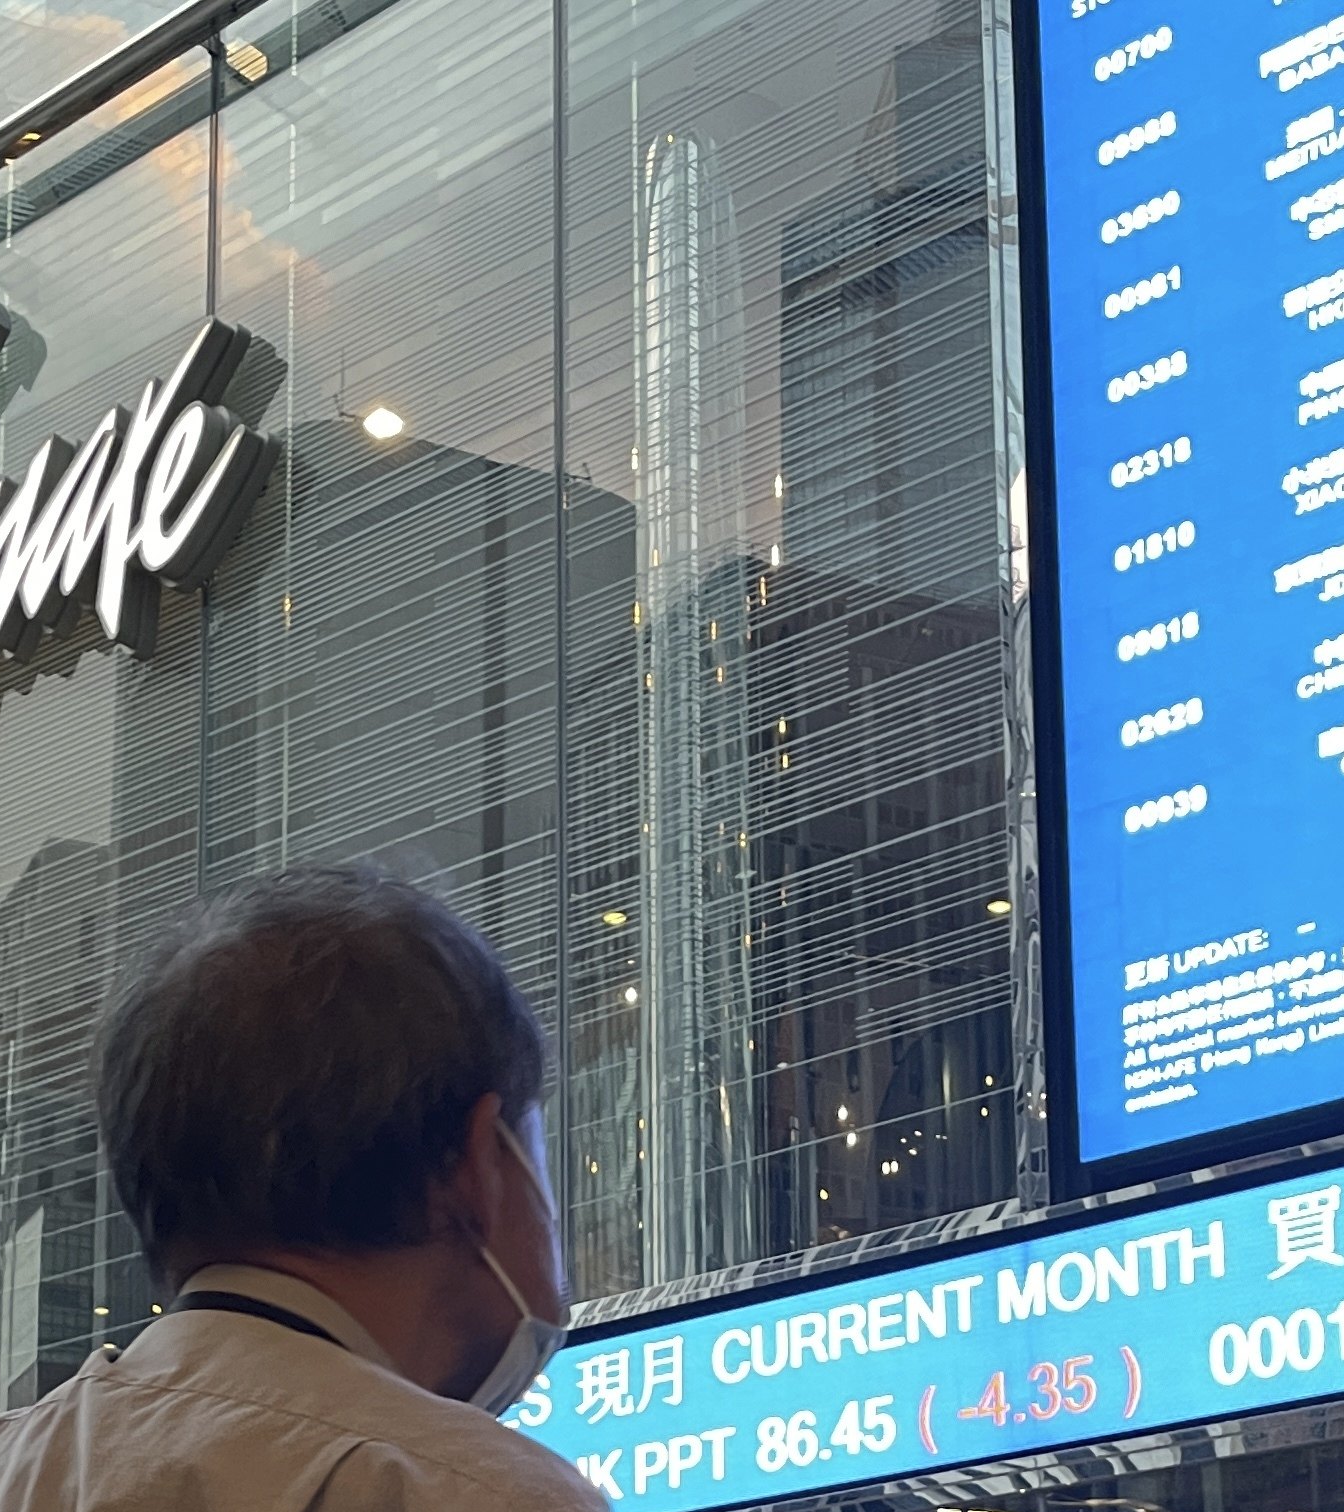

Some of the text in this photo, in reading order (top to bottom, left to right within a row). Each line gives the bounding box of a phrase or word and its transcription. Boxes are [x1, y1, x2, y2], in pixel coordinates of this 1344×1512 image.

[1094, 27, 1173, 82] 00700
[1110, 436, 1192, 488] 02318
[1114, 521, 1196, 572] 01810
[575, 1336, 684, 1424] 現月
[711, 1276, 984, 1384] CURRENT
[997, 1221, 1225, 1324] MONTH
[634, 1427, 737, 1495] PPT
[756, 1395, 897, 1474] 86.45
